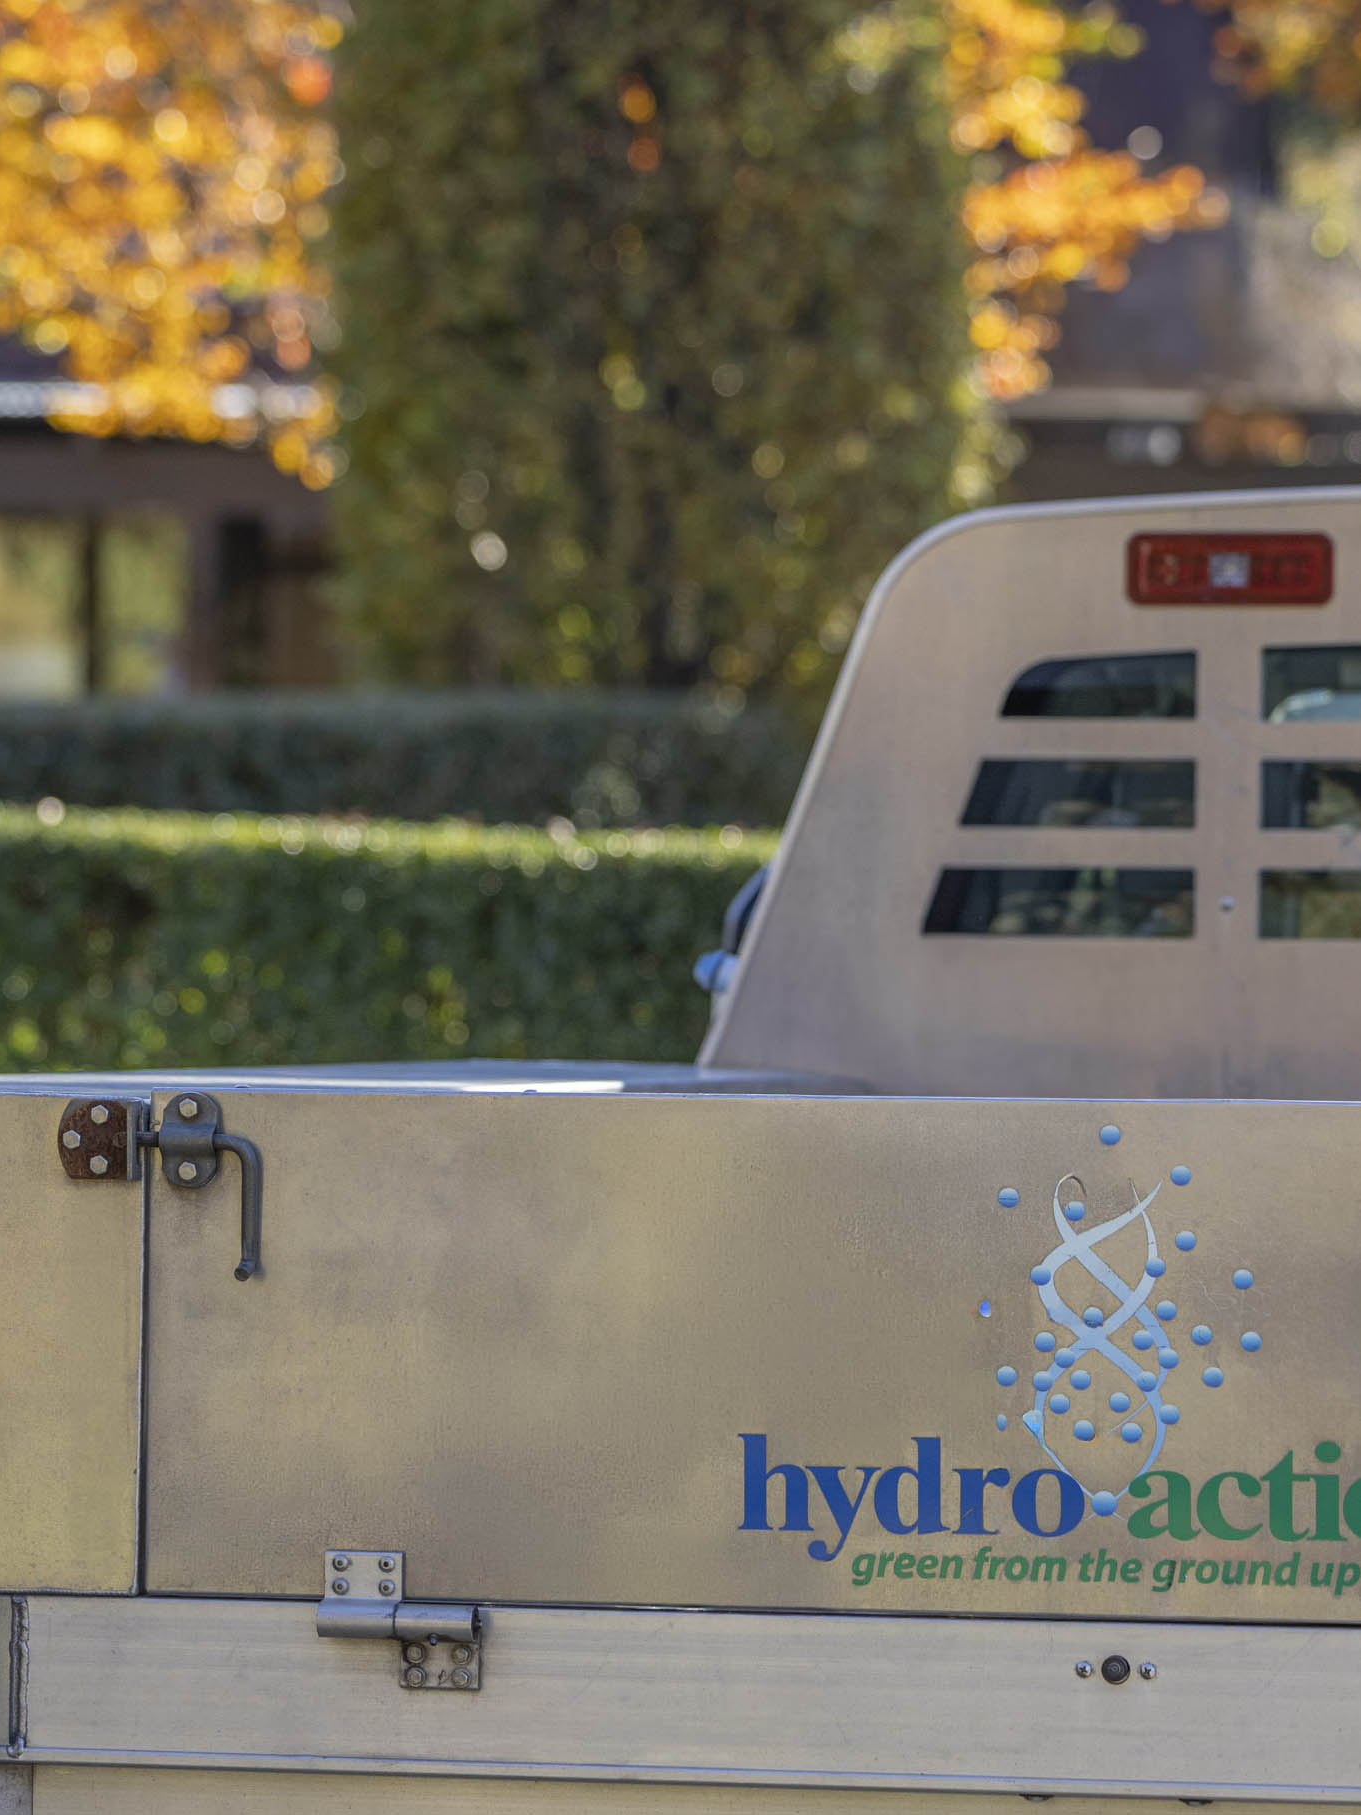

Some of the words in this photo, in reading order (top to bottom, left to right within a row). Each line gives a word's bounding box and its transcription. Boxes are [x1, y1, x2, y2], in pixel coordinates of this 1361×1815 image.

[738, 1433, 1086, 1562] hydro
[1127, 1441, 1361, 1542] acti
[851, 1550, 964, 1587] green
[971, 1546, 1068, 1583] from
[1078, 1548, 1143, 1584] the
[1151, 1552, 1302, 1593] ground
[1310, 1559, 1361, 1597] up
